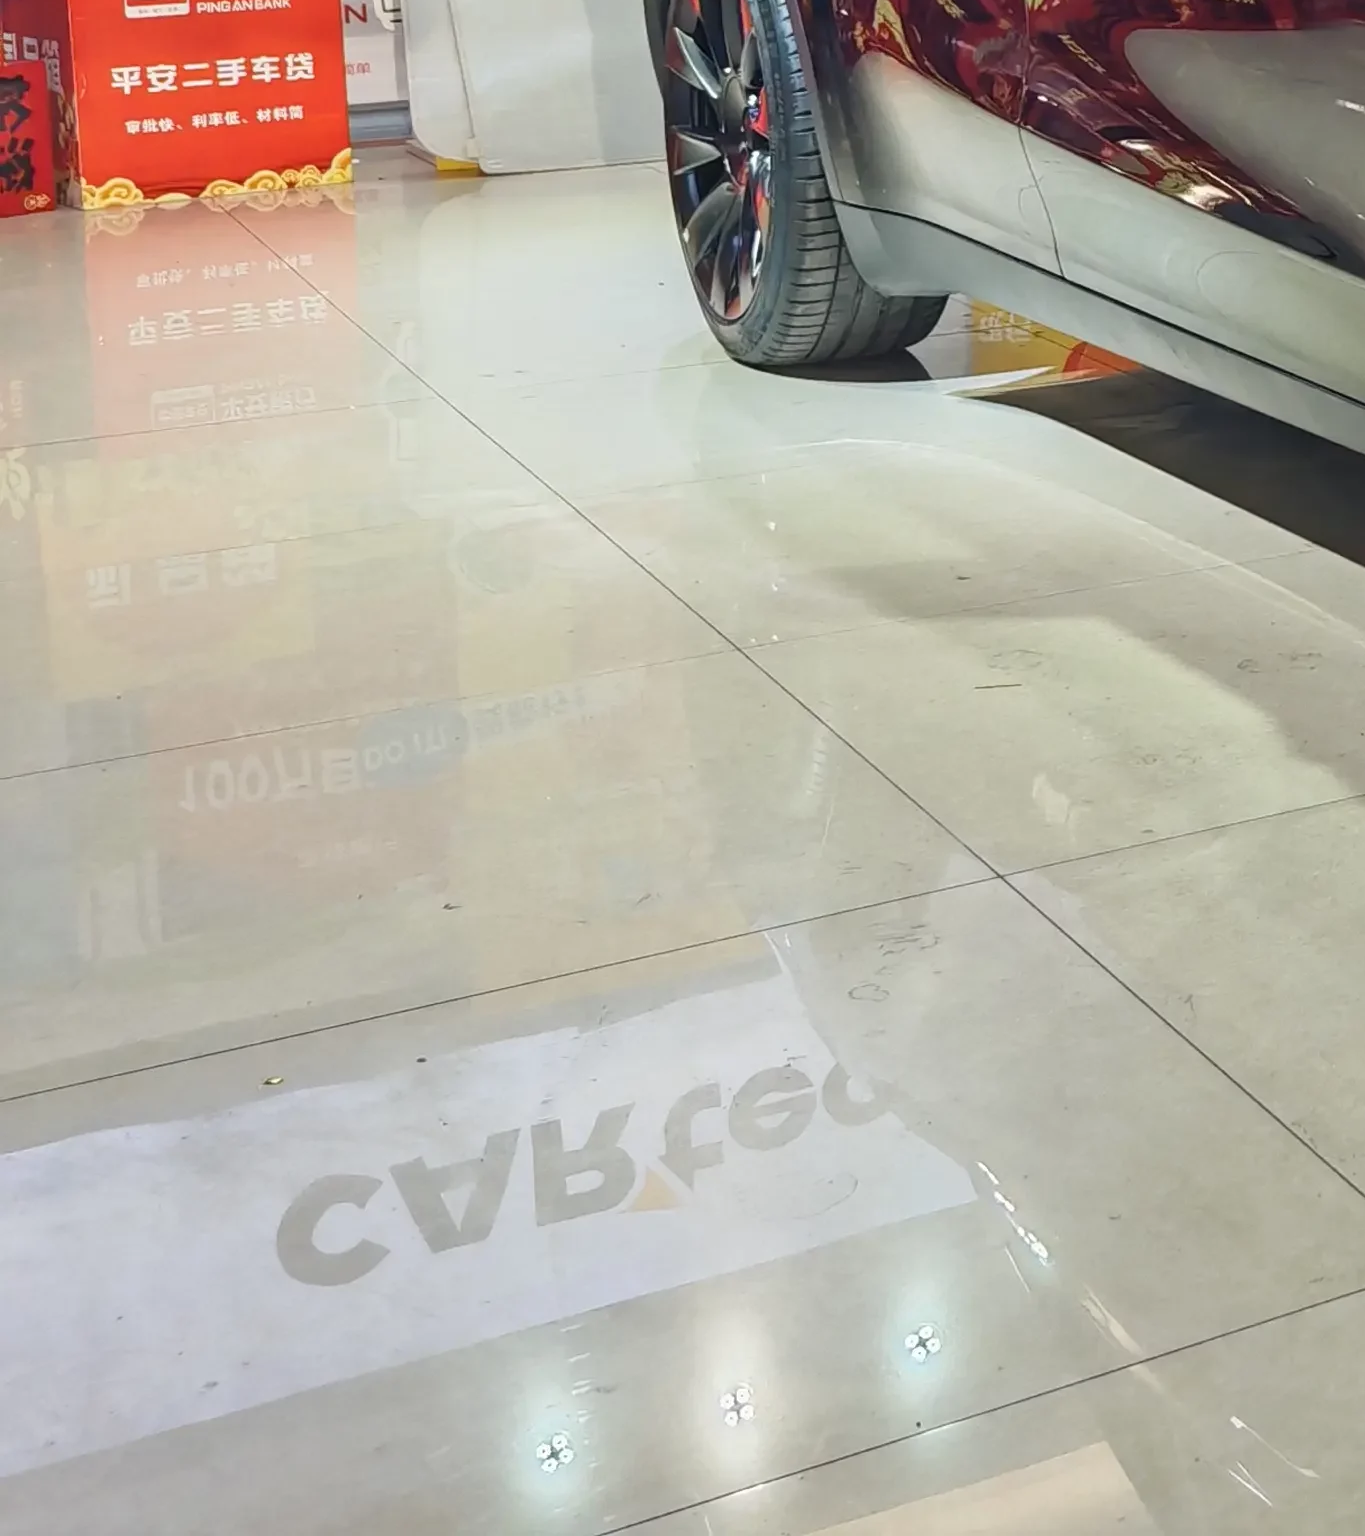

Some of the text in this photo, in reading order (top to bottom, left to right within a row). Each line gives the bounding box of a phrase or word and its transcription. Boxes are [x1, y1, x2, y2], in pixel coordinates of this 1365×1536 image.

[110, 52, 316, 96] 平安二手车贷
